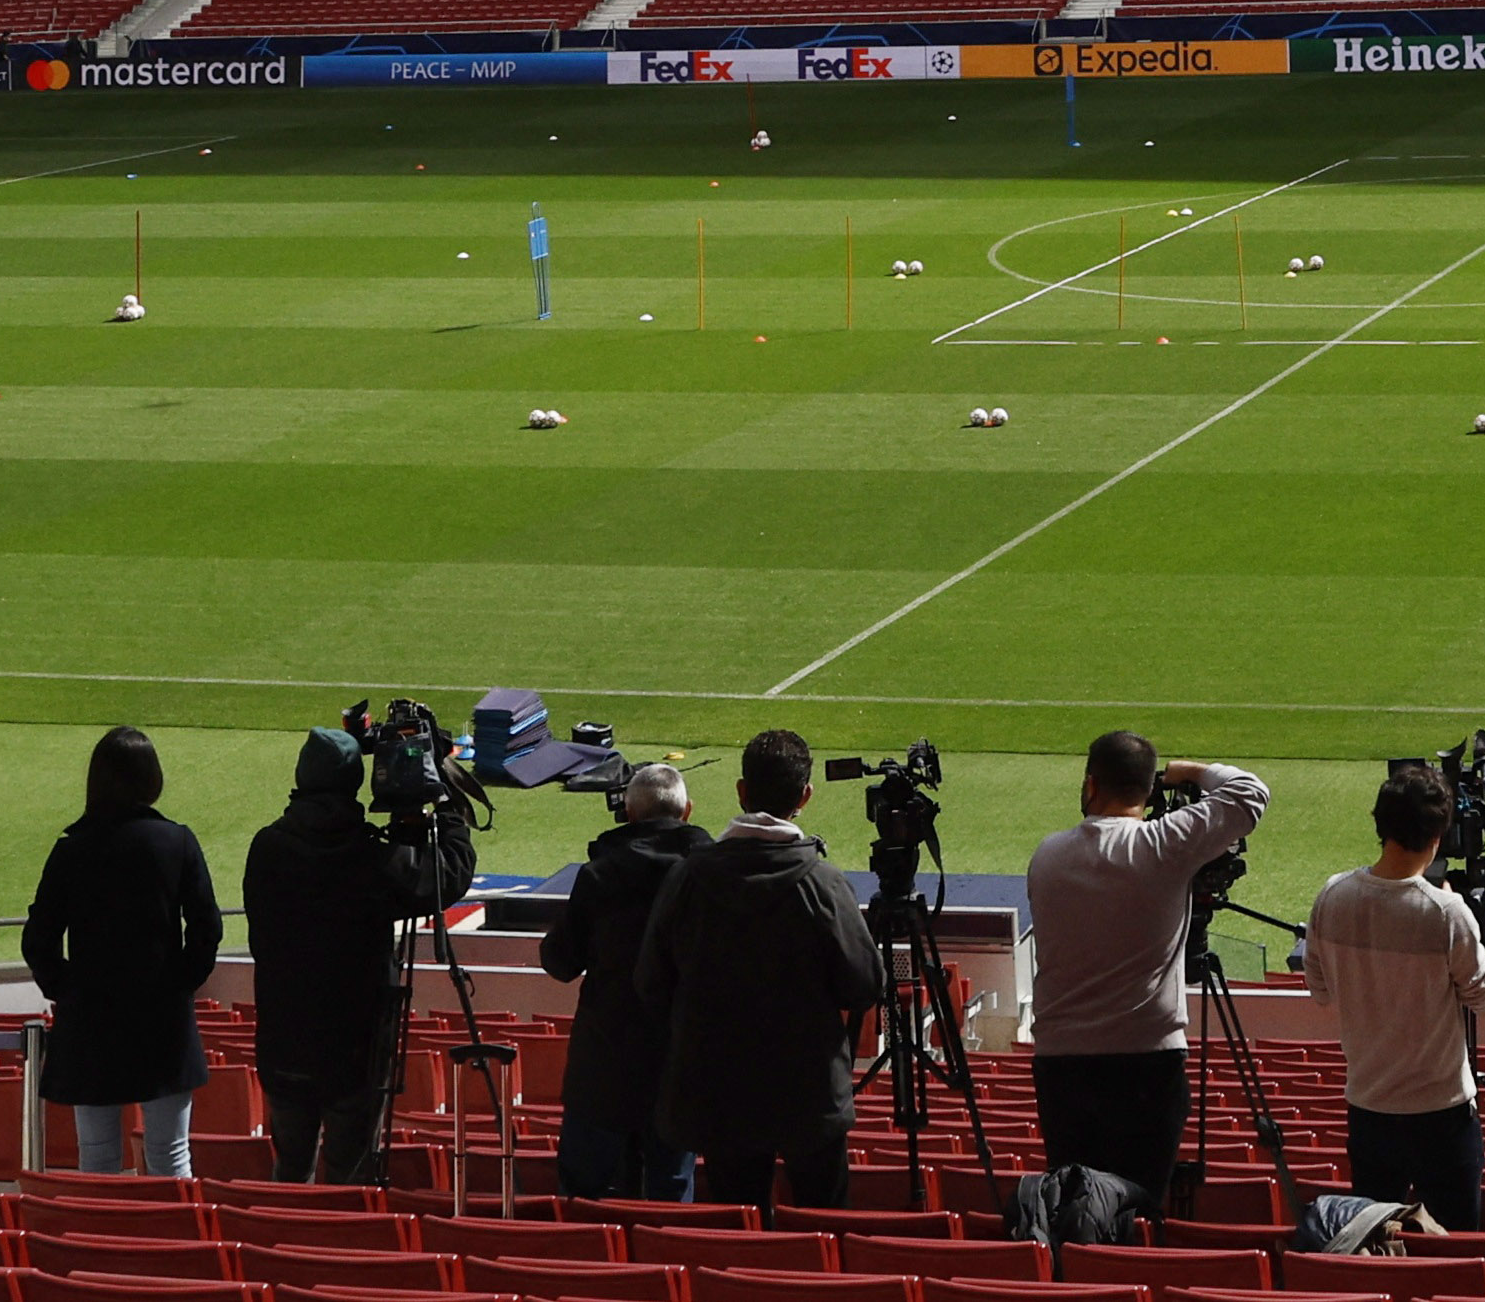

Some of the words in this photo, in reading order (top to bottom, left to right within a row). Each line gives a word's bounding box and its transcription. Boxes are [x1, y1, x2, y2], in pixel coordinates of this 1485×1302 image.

[81, 56, 286, 87] mastercard
[390, 62, 451, 81] PEACE
[640, 50, 734, 83] FedEx
[798, 47, 893, 80] FedEx
[1077, 42, 1213, 78] Expedia
